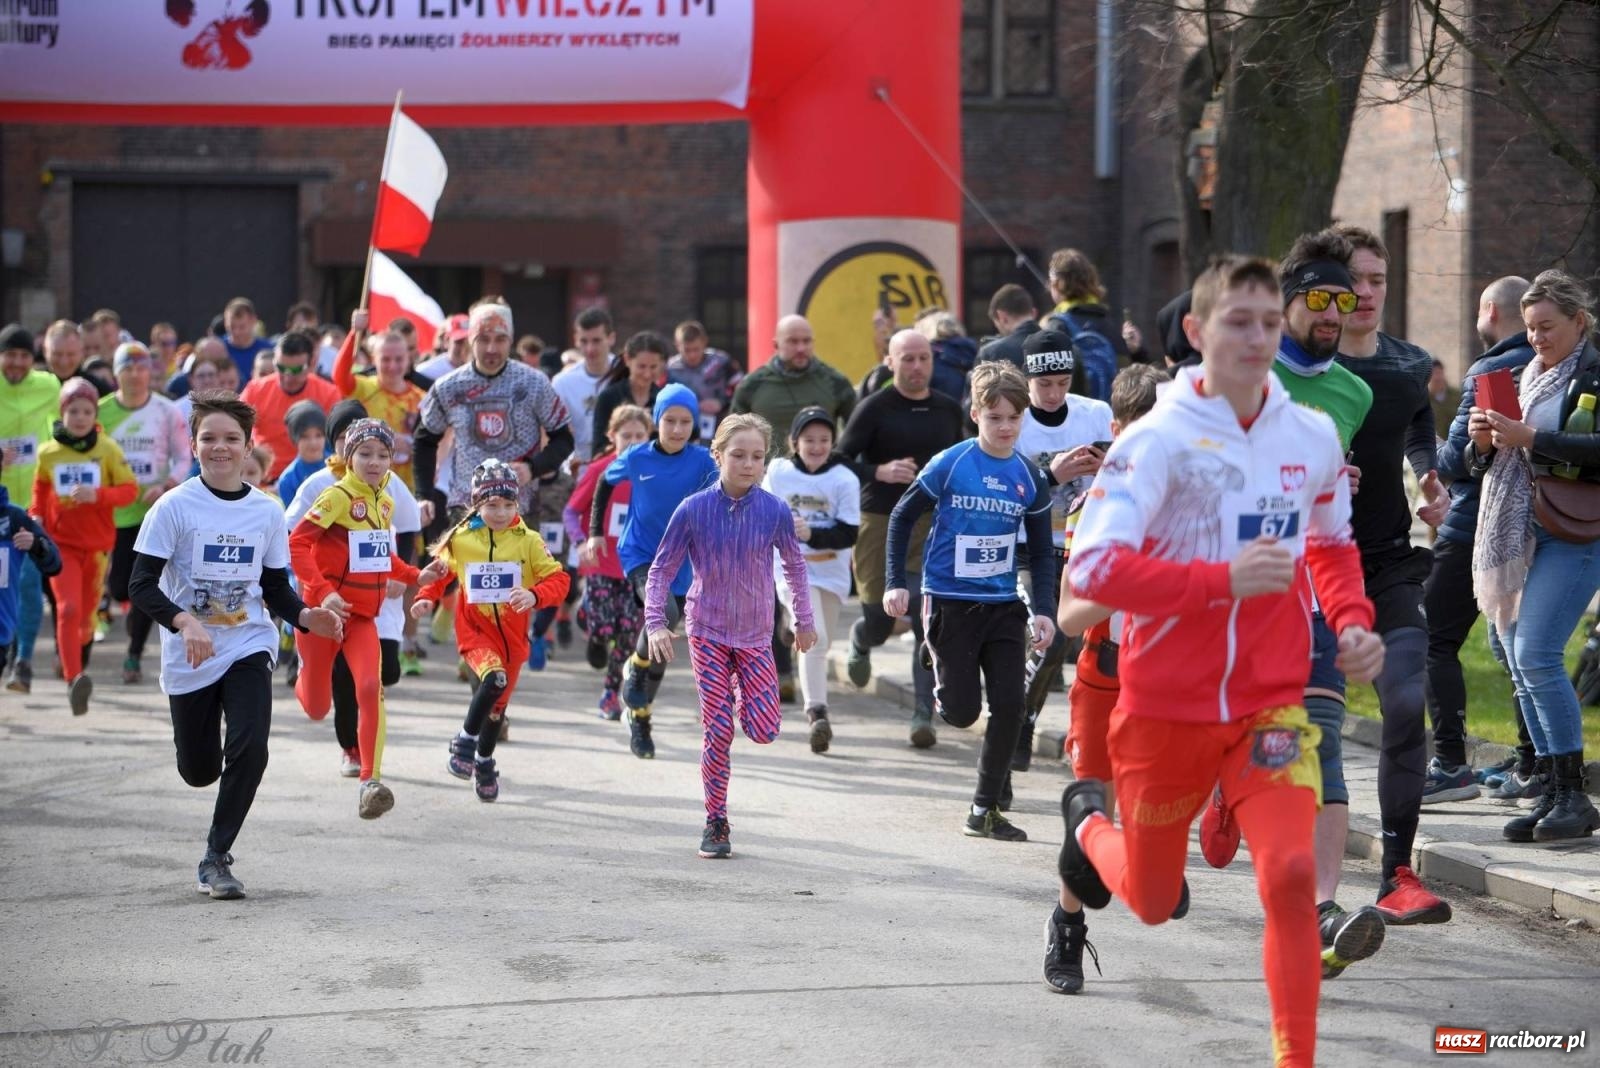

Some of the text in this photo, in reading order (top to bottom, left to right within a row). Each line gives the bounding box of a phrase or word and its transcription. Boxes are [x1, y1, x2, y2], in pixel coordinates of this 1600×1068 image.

[327, 31, 681, 50] BIEG PAMIĘCI ŻOŁNIERZY WYKLĘTYCH
[1026, 351, 1074, 366] PITBULL
[1261, 514, 1290, 538] 67
[218, 546, 240, 562] 44
[371, 542, 388, 557] 70
[979, 548, 998, 562] 33
[481, 575, 501, 588] 68
